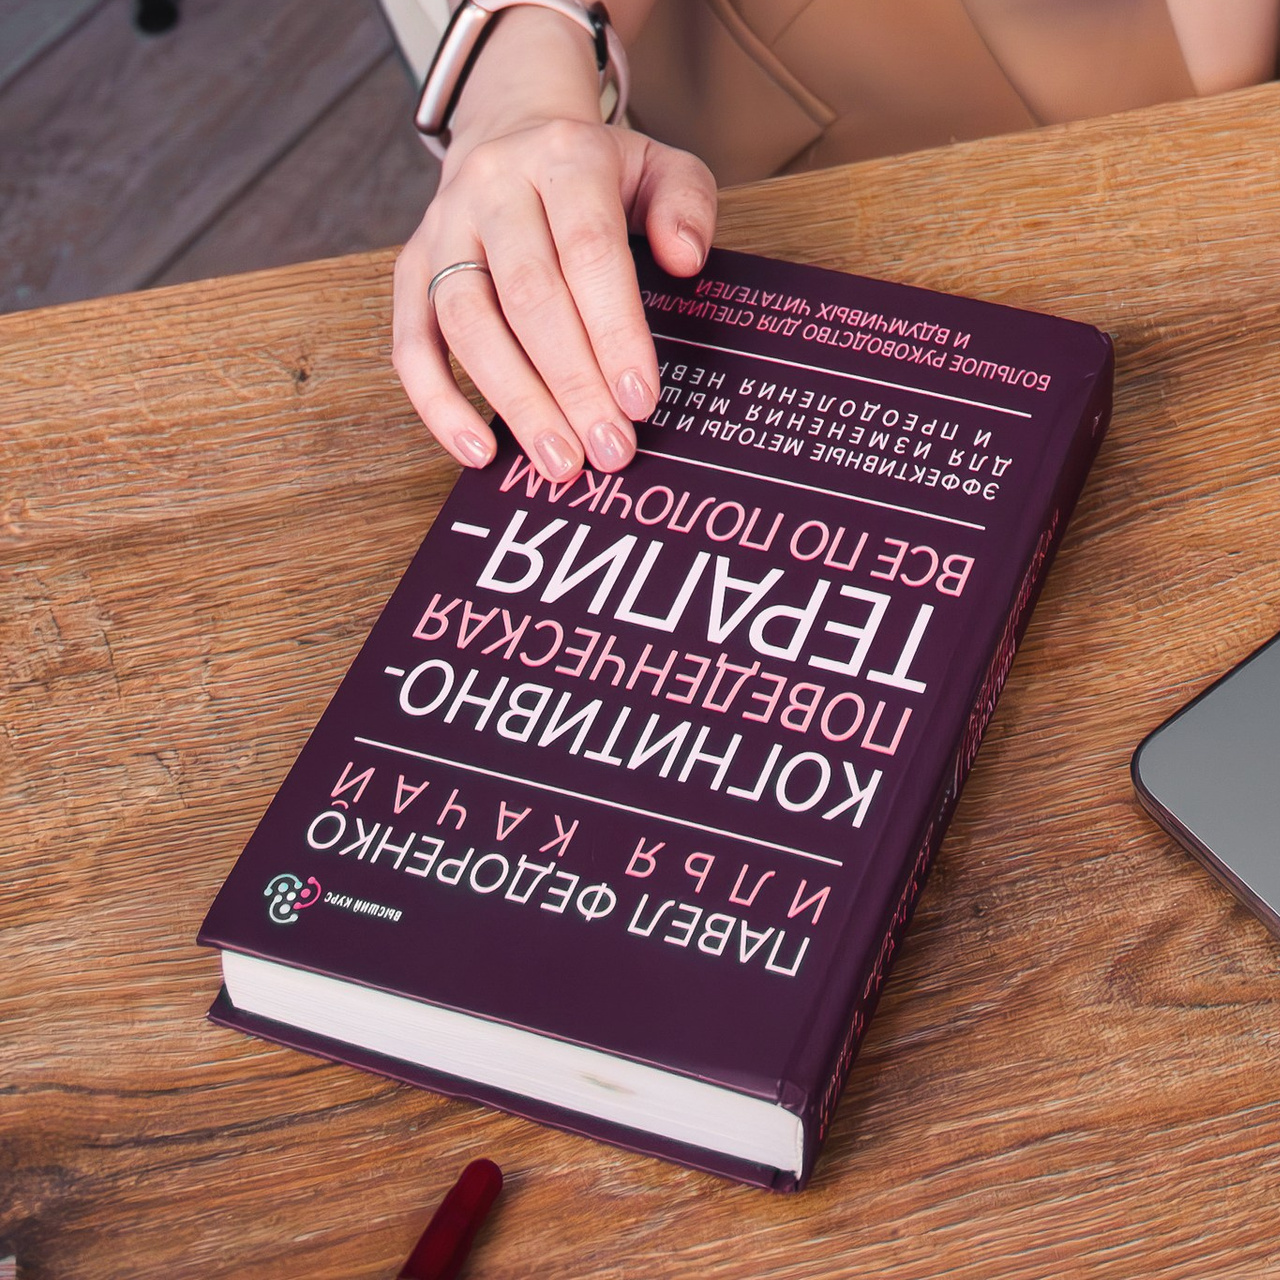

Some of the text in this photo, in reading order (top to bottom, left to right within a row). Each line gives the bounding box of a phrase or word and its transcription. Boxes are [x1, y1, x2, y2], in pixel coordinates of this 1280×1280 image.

[642, 290, 1051, 392] БОЛЬШОЕ РУКОВОДСТВО ДЛЯ СПЕЦИАЛИС
[696, 277, 971, 349] И ВДУМЧИВЫХ ЧИТАТЕЛЕЙ
[659, 385, 1013, 477] ДЛЯ ИЗМЕНЕНИЯ МЫШ
[676, 414, 695, 432] И
[700, 418, 804, 456] МЕТОДЫ
[738, 378, 959, 440] ПРЕОДОЛЕНИЯ
[973, 429, 992, 448] И
[810, 443, 1000, 500] ЭФФЕКТИВНЫЕ
[499, 454, 976, 597] ВСЕ ПО ПОЛОЧКАМ
[412, 593, 913, 756] ПОВЕДЕНЧЕСКАЯ
[384, 658, 883, 828] КОГНИТИВНО-
[329, 761, 580, 857] КАЧАЙ
[306, 810, 617, 921] ФЕДОРЕНКО
[323, 891, 402, 922] ВЫСШИЙ КУРС
[625, 836, 831, 926] ИЛЬЯ
[627, 893, 811, 977] ПАВЕЛ
